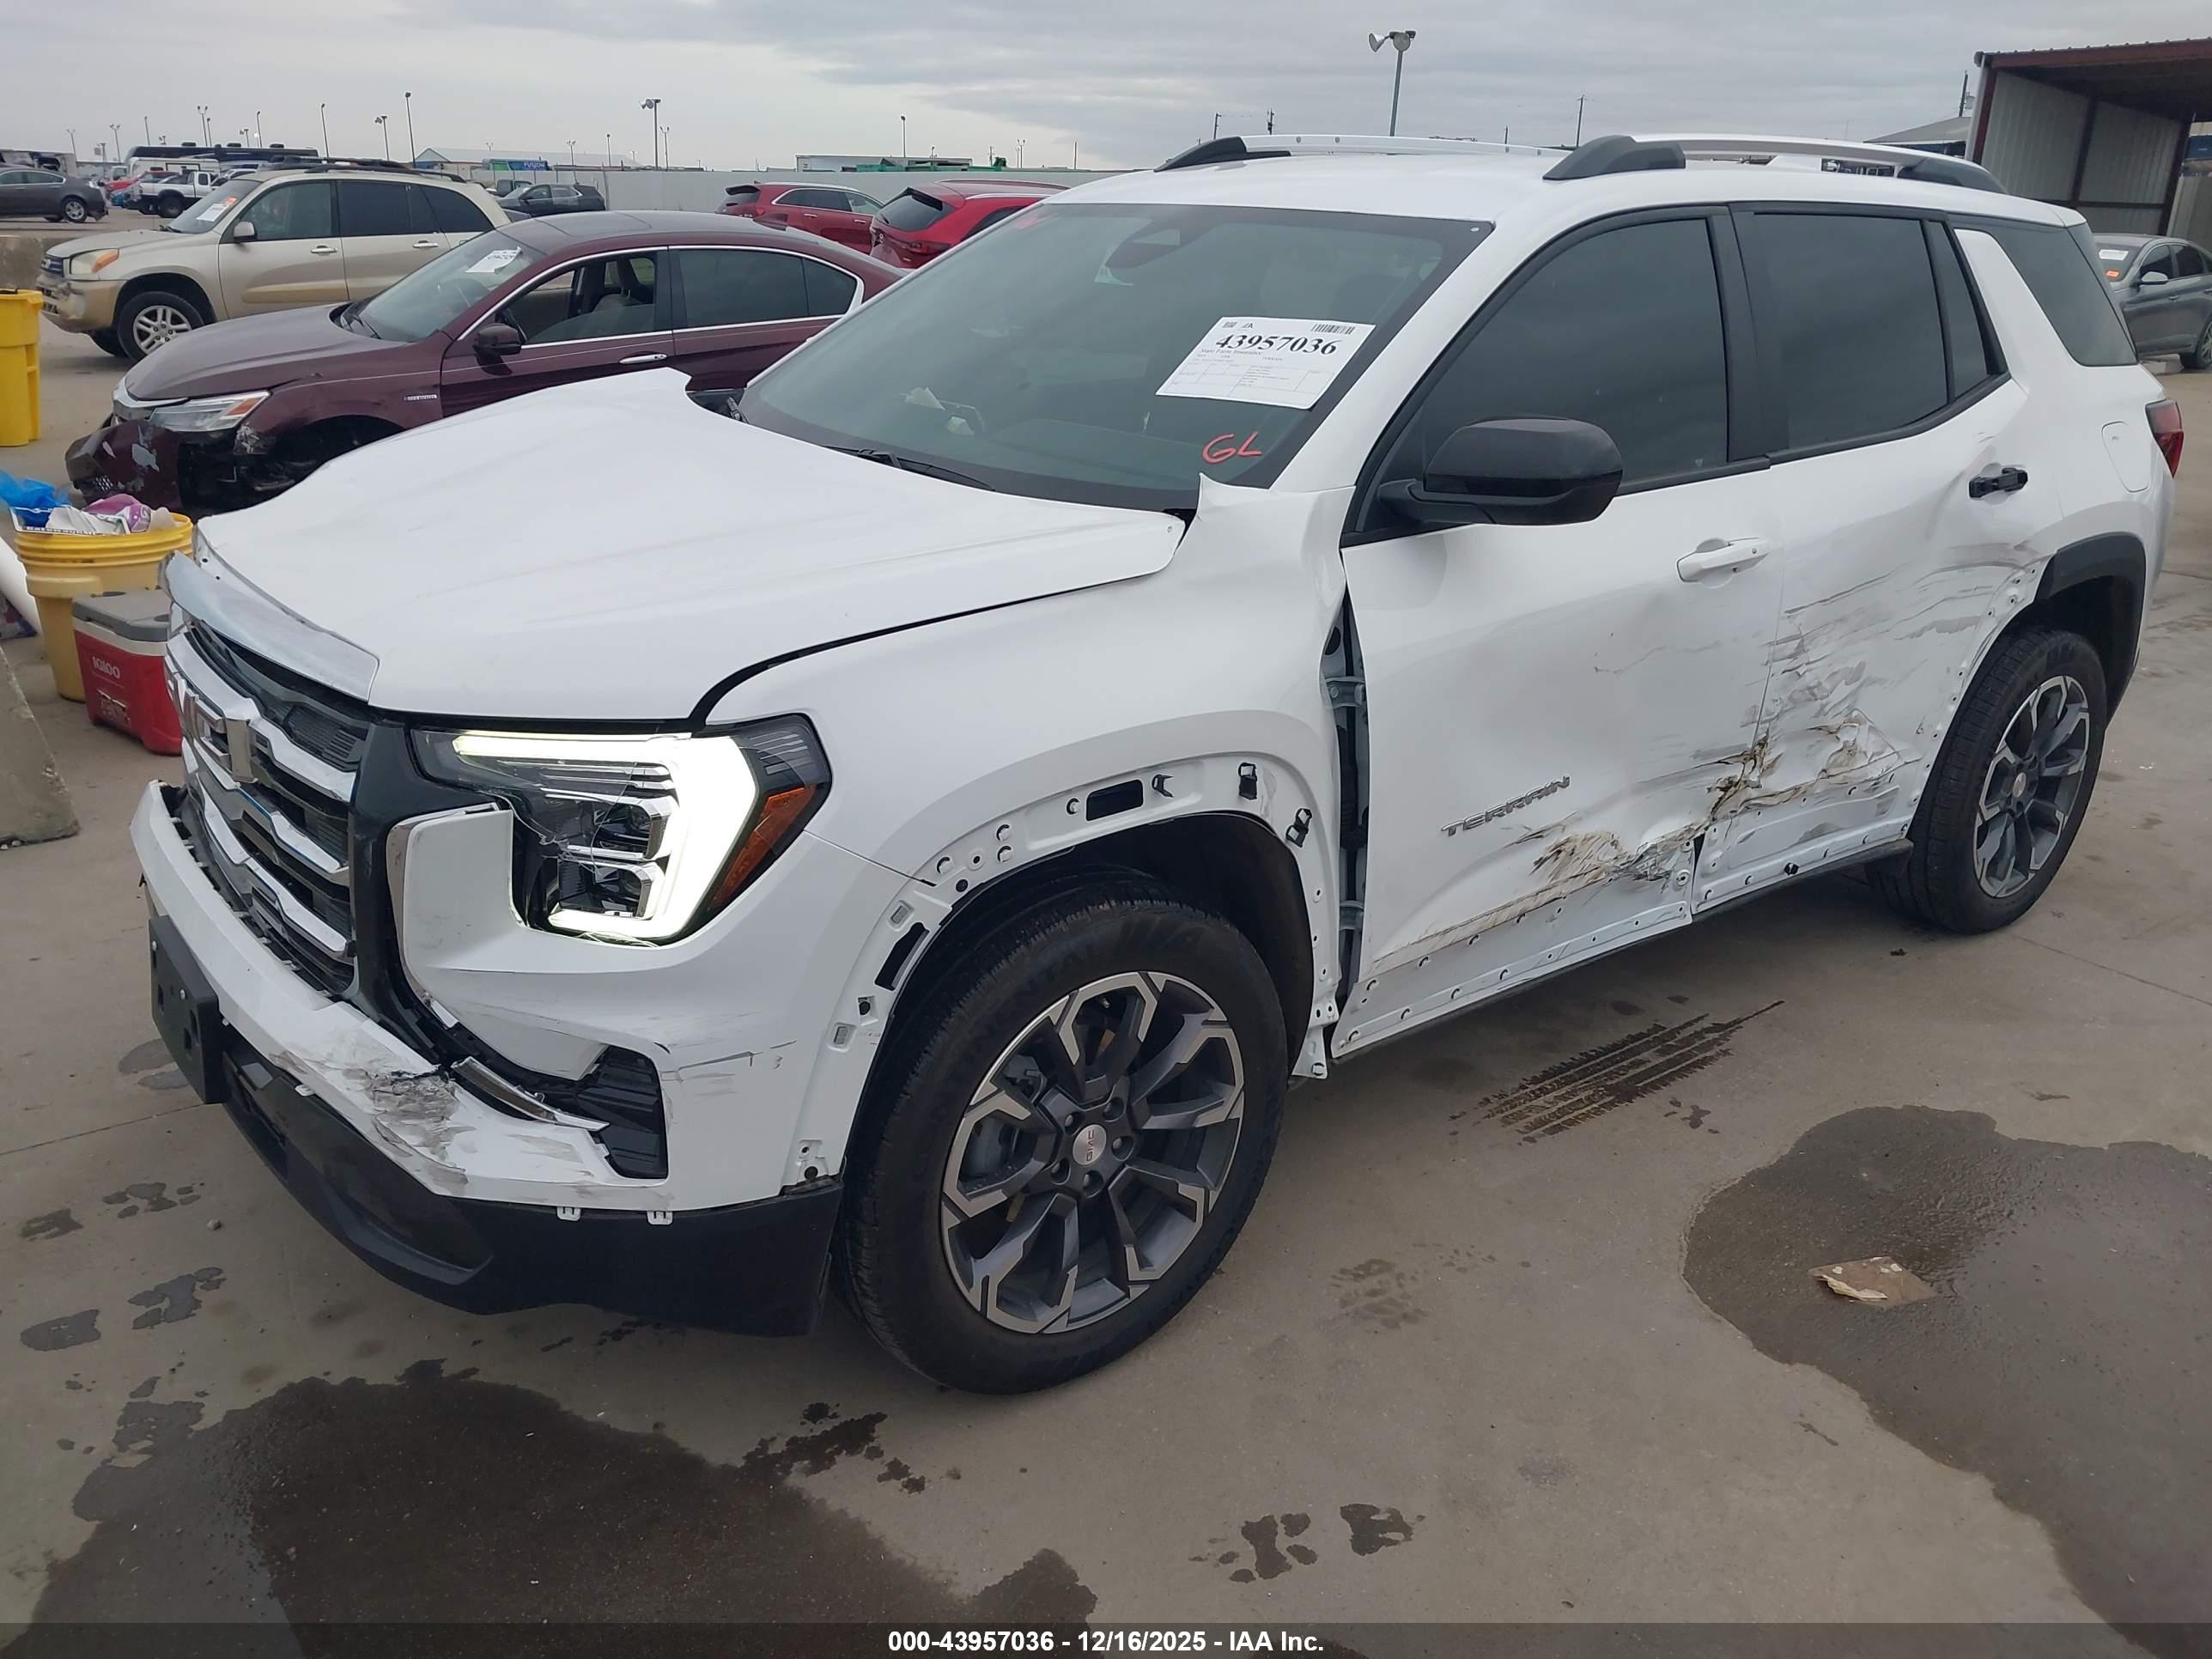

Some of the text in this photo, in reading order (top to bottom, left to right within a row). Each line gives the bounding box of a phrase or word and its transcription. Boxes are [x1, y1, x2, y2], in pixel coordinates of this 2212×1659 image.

[1215, 334, 1343, 355] 43957036
[1202, 431, 1262, 464] GL
[1441, 775, 1571, 836] TERRAIN
[1086, 1129, 1095, 1162] GMC
